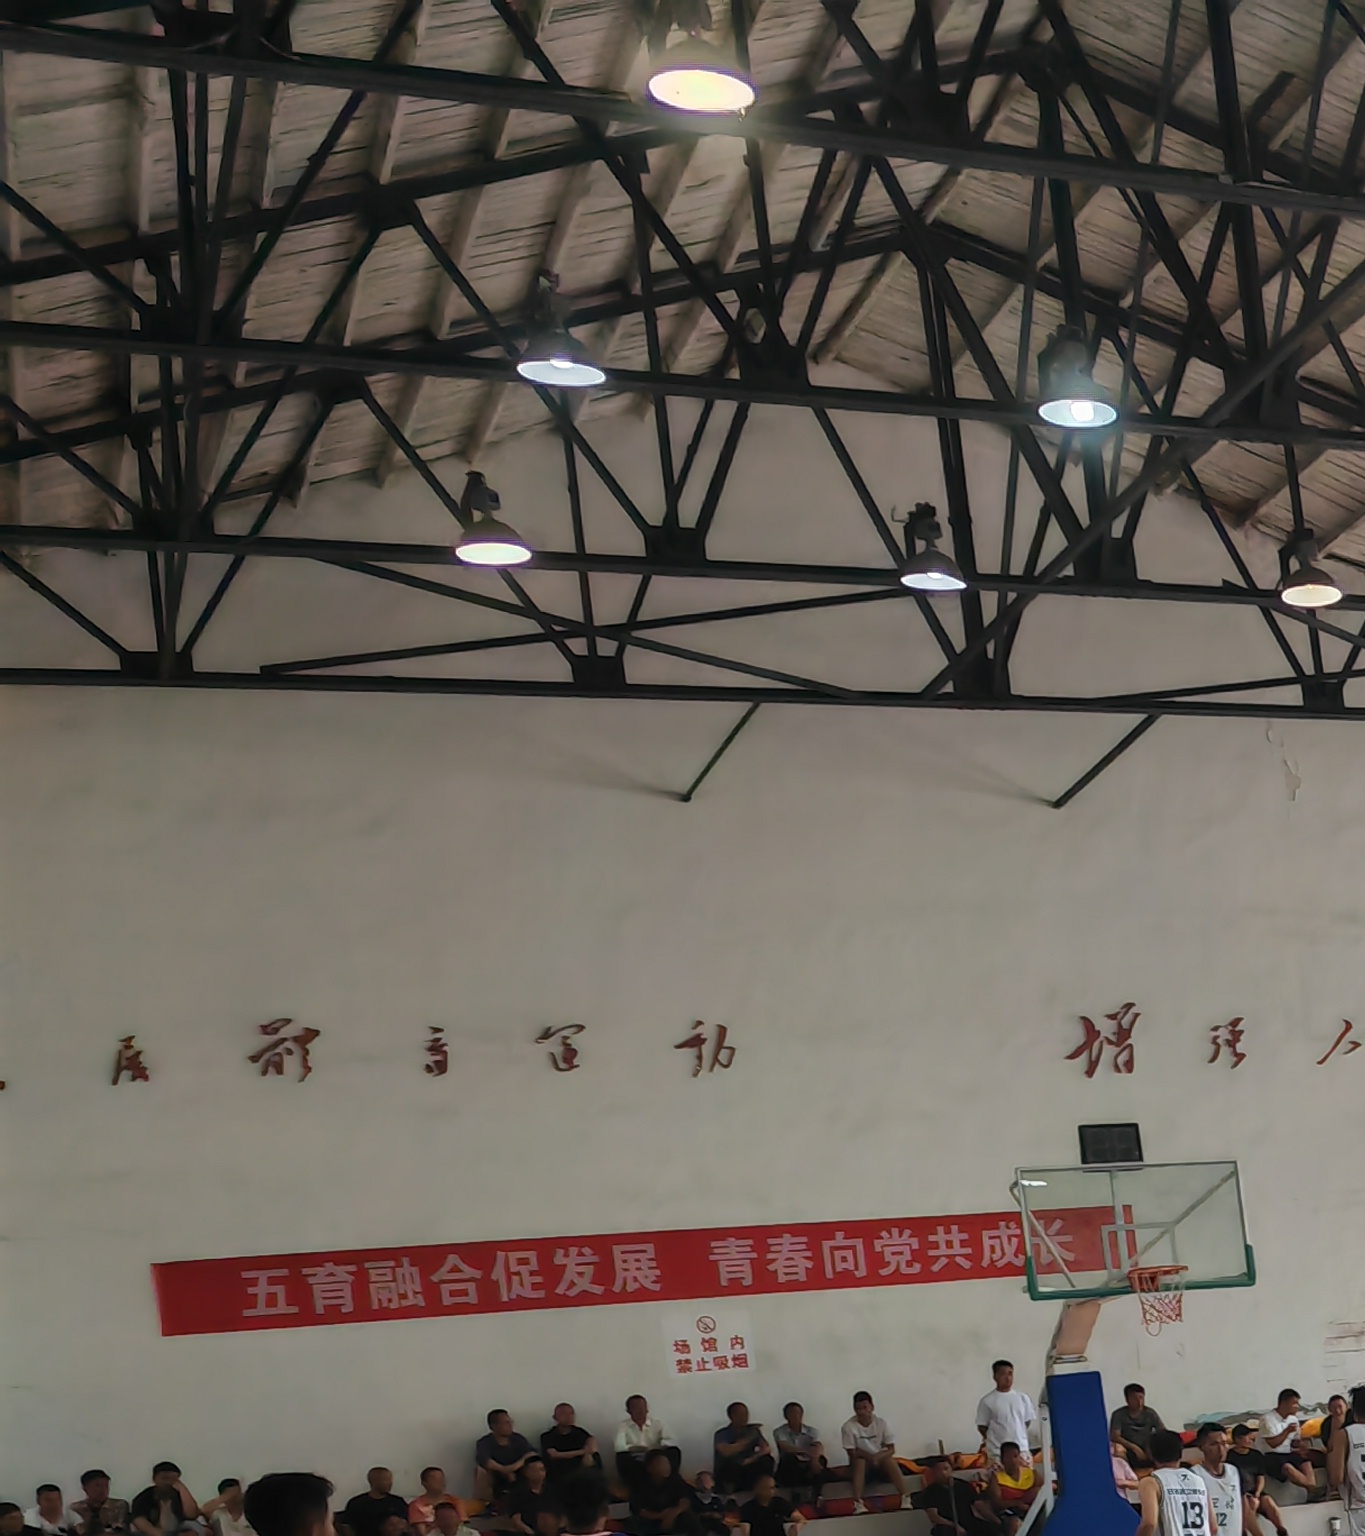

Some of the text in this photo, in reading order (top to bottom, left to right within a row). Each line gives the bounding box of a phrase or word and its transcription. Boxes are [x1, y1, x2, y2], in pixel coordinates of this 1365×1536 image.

[240, 1217, 1076, 1317] 五育融合促发展 青春向党共成长
[672, 1334, 745, 1354] 场馆内
[676, 1353, 749, 1374] 禁止吸烟
[1181, 1501, 1205, 1529] 13
